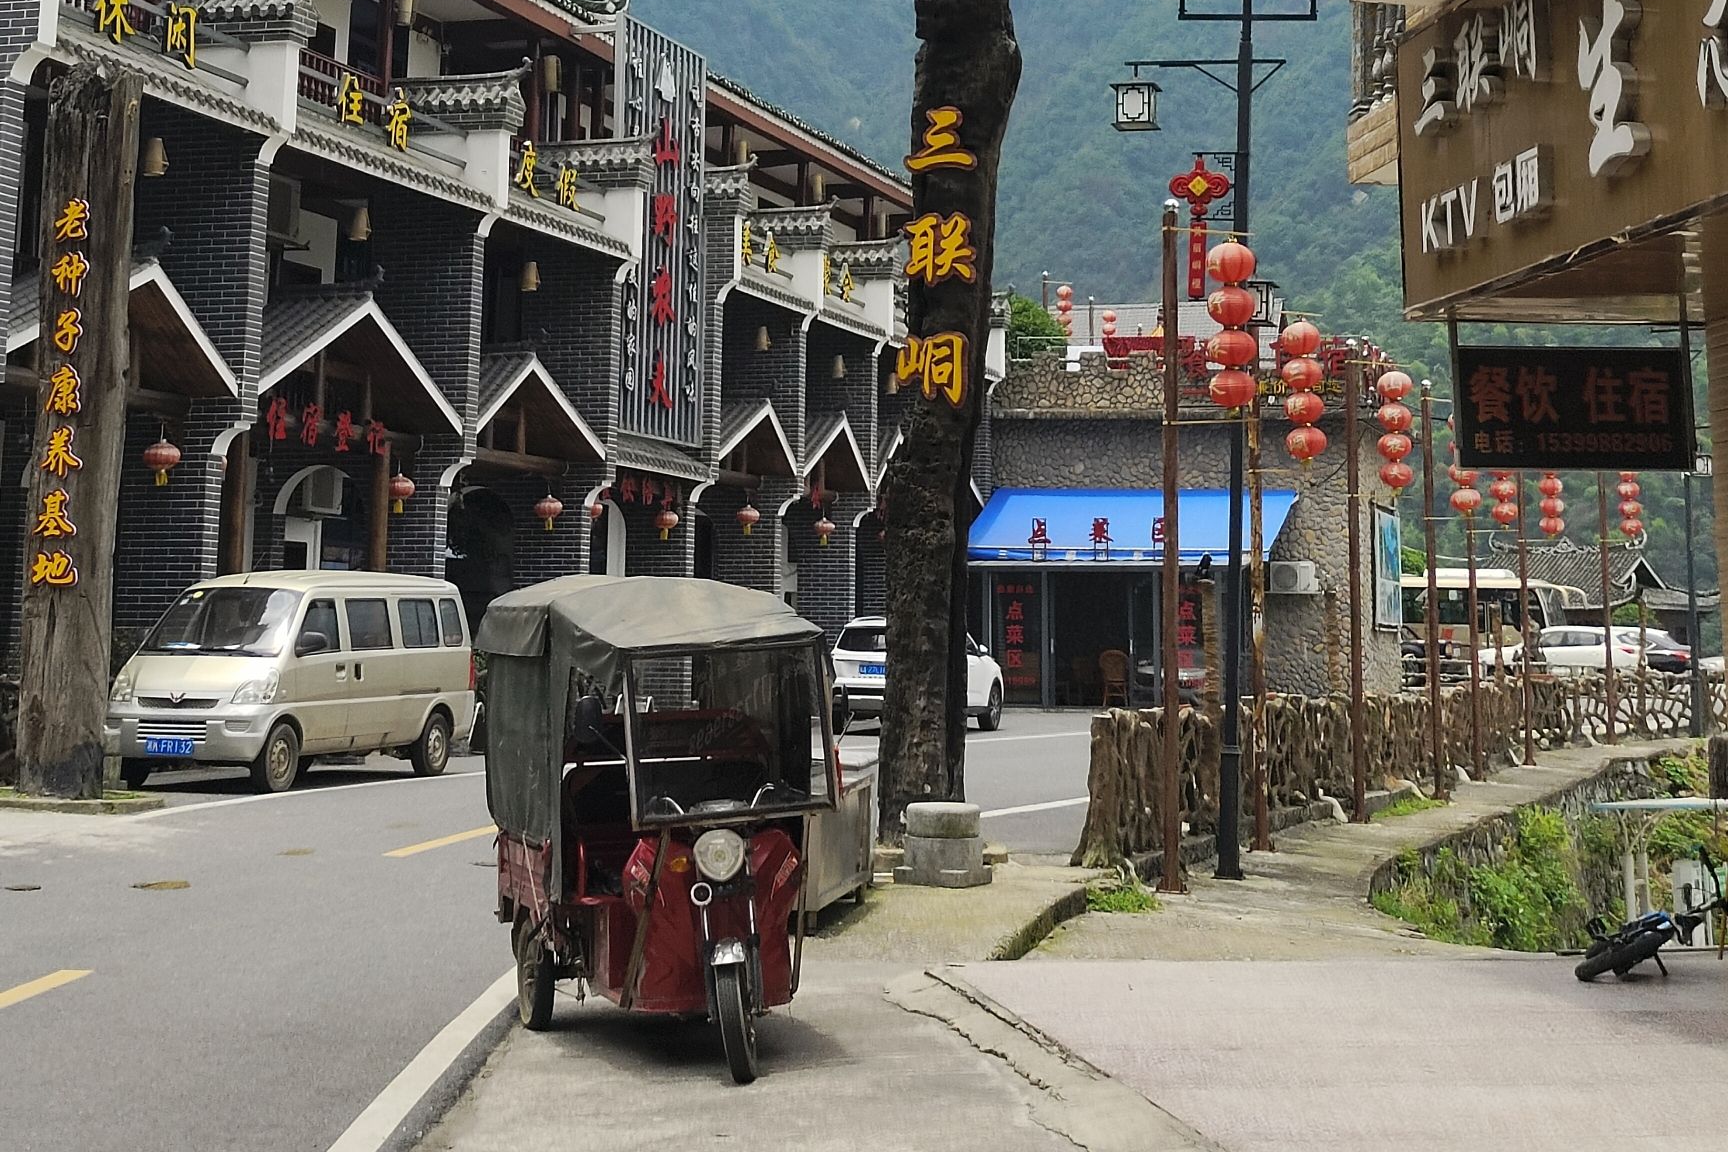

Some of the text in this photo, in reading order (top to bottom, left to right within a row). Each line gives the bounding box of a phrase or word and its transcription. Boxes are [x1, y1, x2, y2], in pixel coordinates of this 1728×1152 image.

[337, 72, 407, 150] 住宿
[515, 141, 580, 211] 度假
[1421, 147, 1539, 254] KTV 包厢
[898, 107, 976, 407] 三联峒
[32, 199, 88, 586] 老种子康养基地
[1470, 365, 1670, 424] 餐饮 住宿
[1005, 600, 1025, 668] 点菜区
